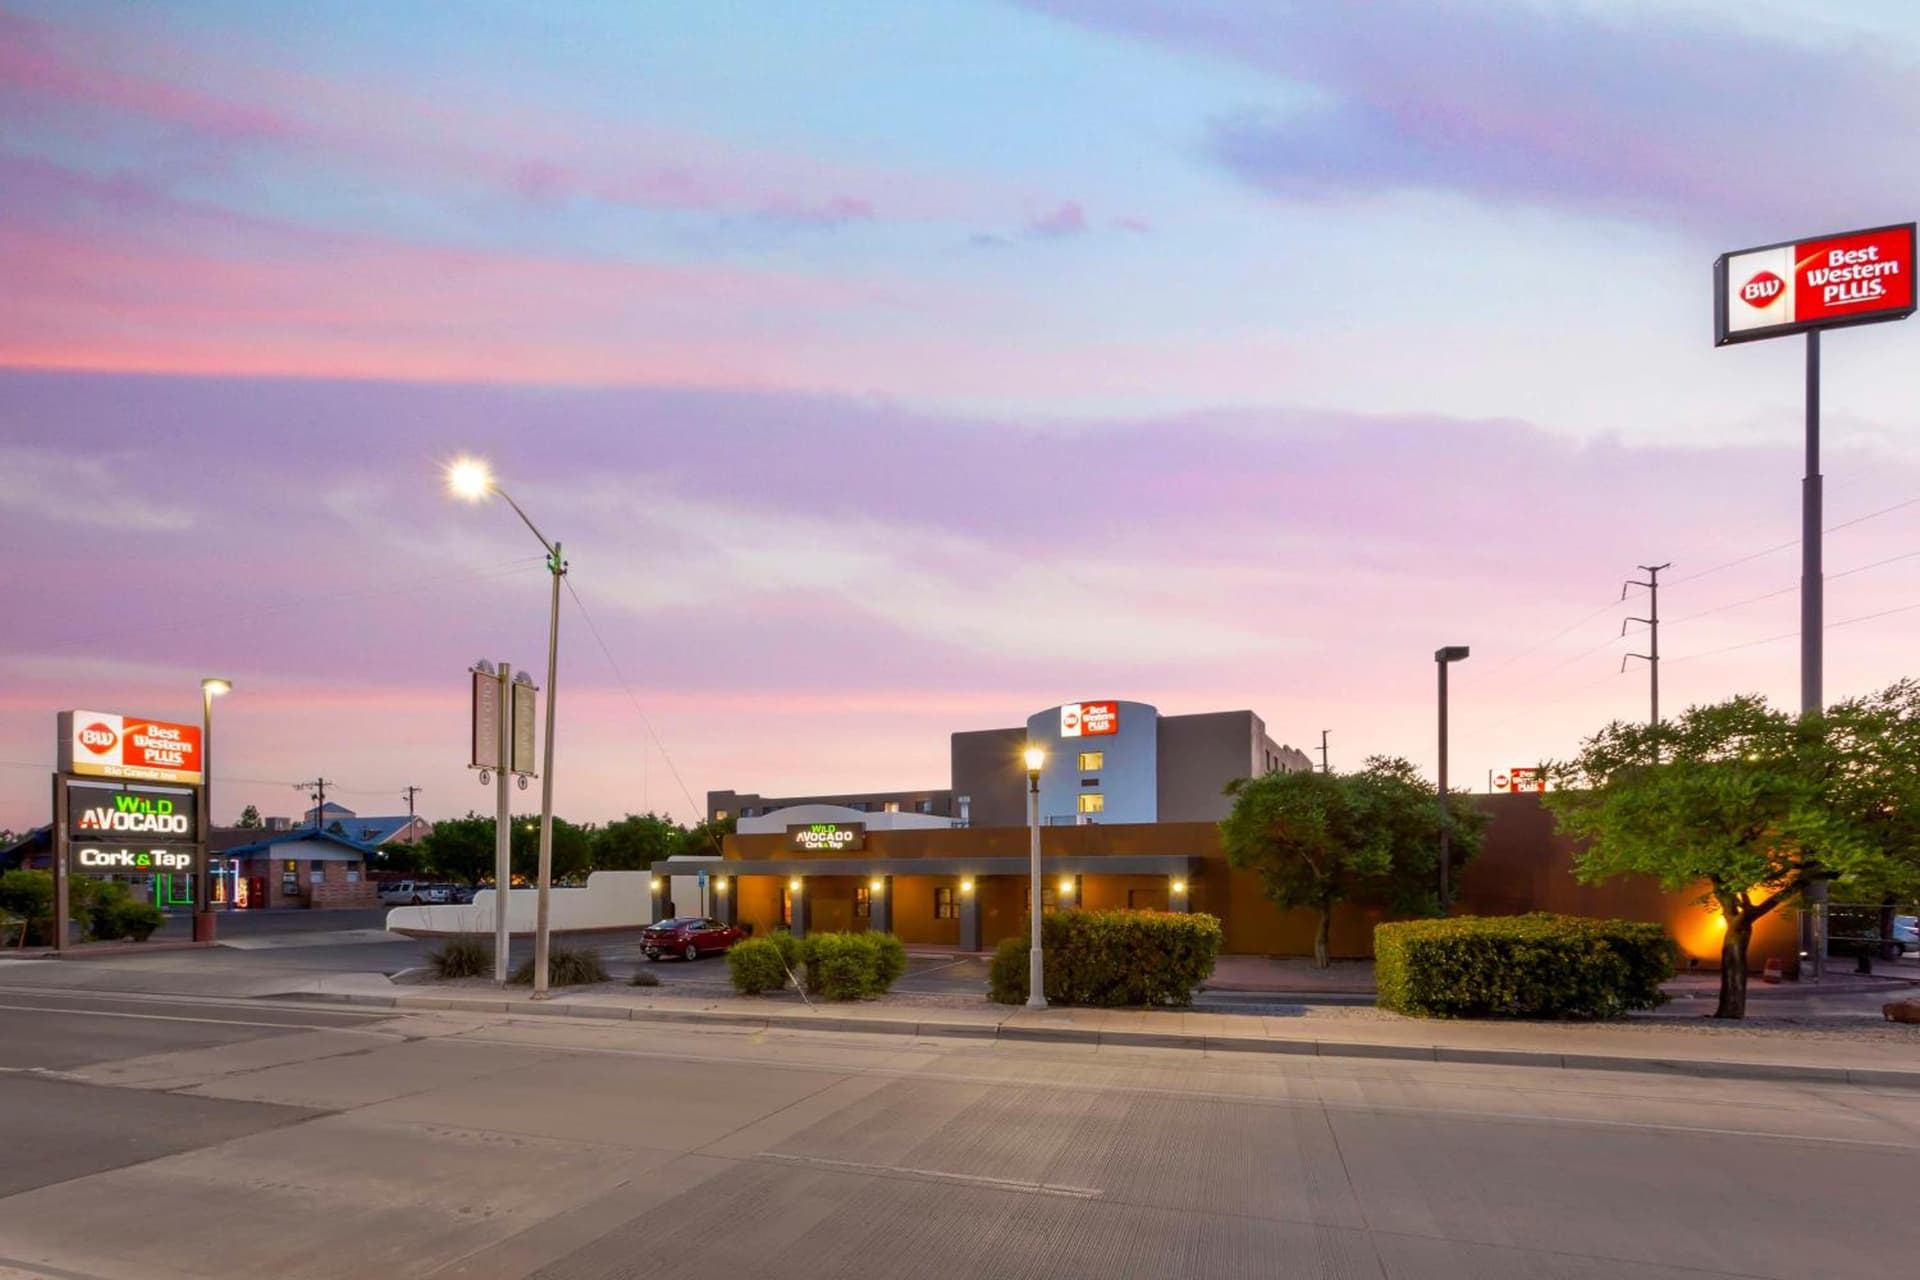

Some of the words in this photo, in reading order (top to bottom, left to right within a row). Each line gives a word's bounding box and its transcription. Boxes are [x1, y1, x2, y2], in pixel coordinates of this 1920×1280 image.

[1829, 245, 1879, 267] Best
[1807, 260, 1899, 287] Western
[1745, 278, 1780, 300] BW
[82, 729, 114, 746] BW
[147, 725, 180, 740] Best
[133, 735, 192, 753] Western
[144, 748, 183, 764] PLUS
[79, 808, 188, 833] AVOCADO
[796, 831, 853, 842] AVOCADO
[80, 848, 136, 866] Cork
[150, 849, 190, 870] Tap
